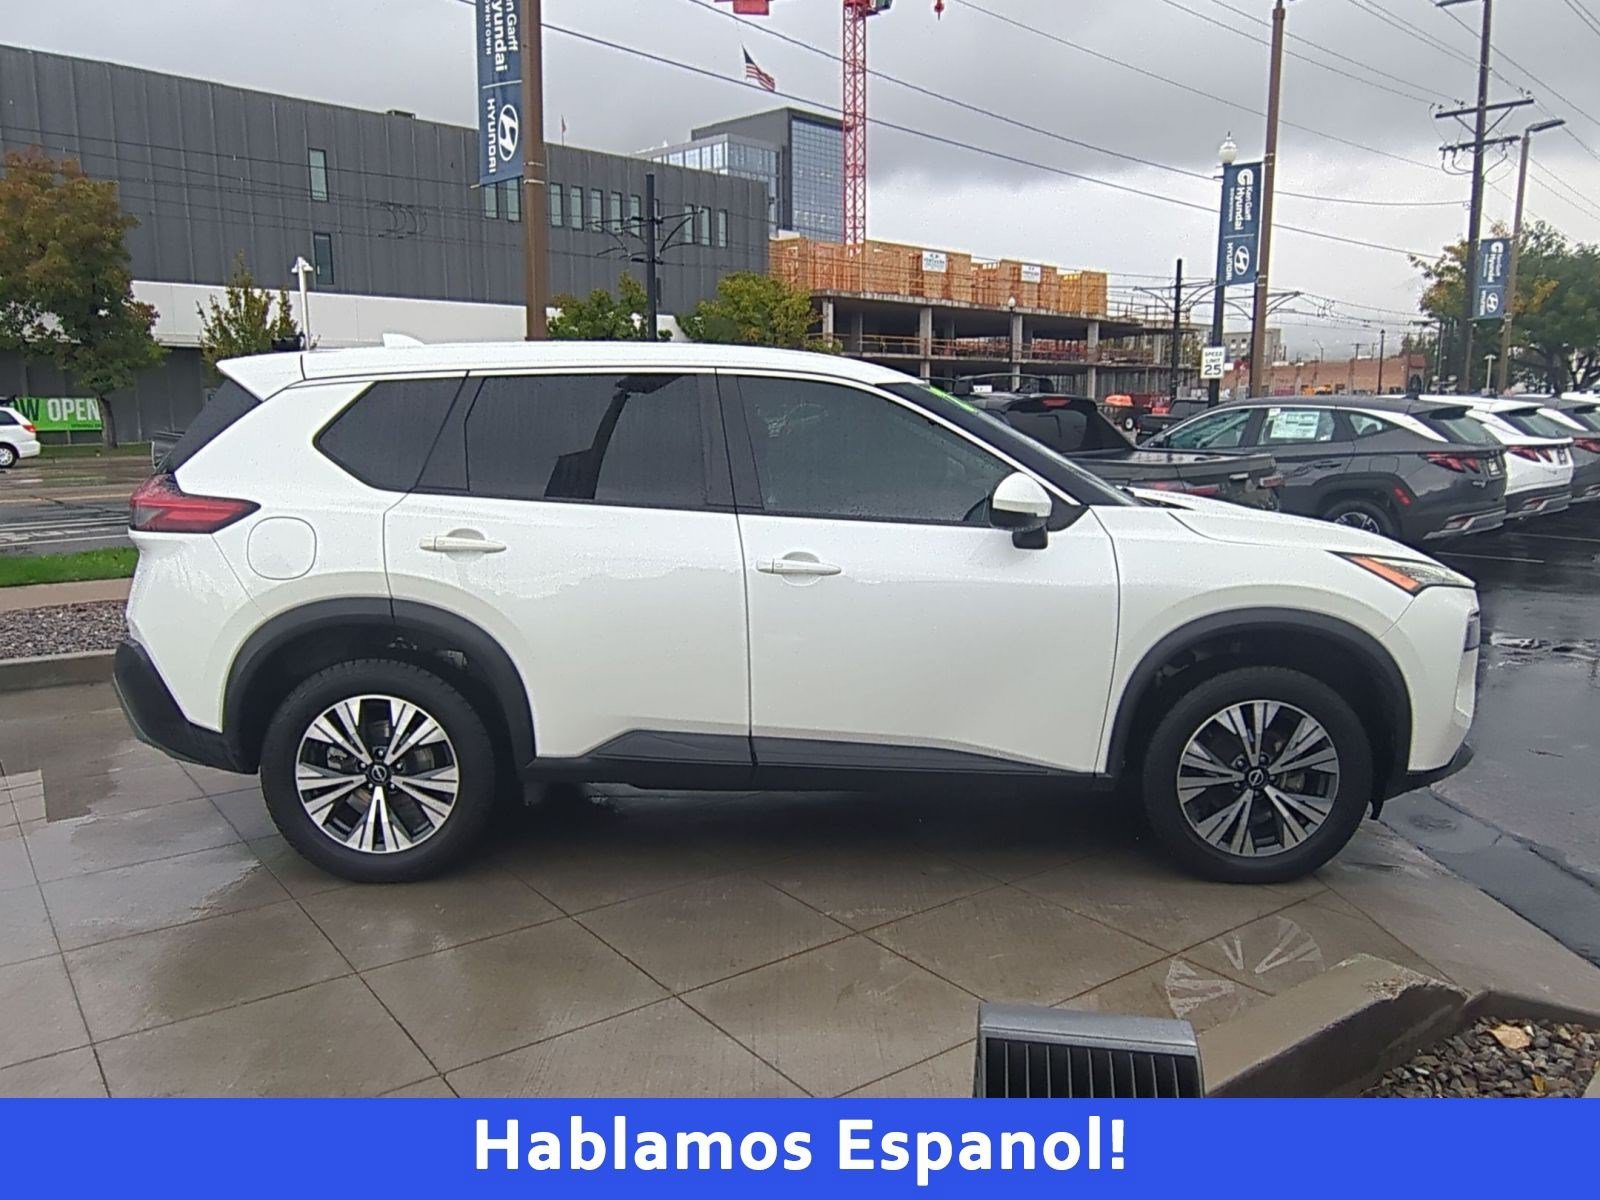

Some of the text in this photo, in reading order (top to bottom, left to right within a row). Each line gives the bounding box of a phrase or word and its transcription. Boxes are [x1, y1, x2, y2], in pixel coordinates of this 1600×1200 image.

[506, 13, 518, 51] Garff
[487, 98, 497, 174] HYUNDAI
[1234, 187, 1244, 230] Hyundai
[1204, 364, 1222, 376] 25
[47, 398, 100, 421] OPEN
